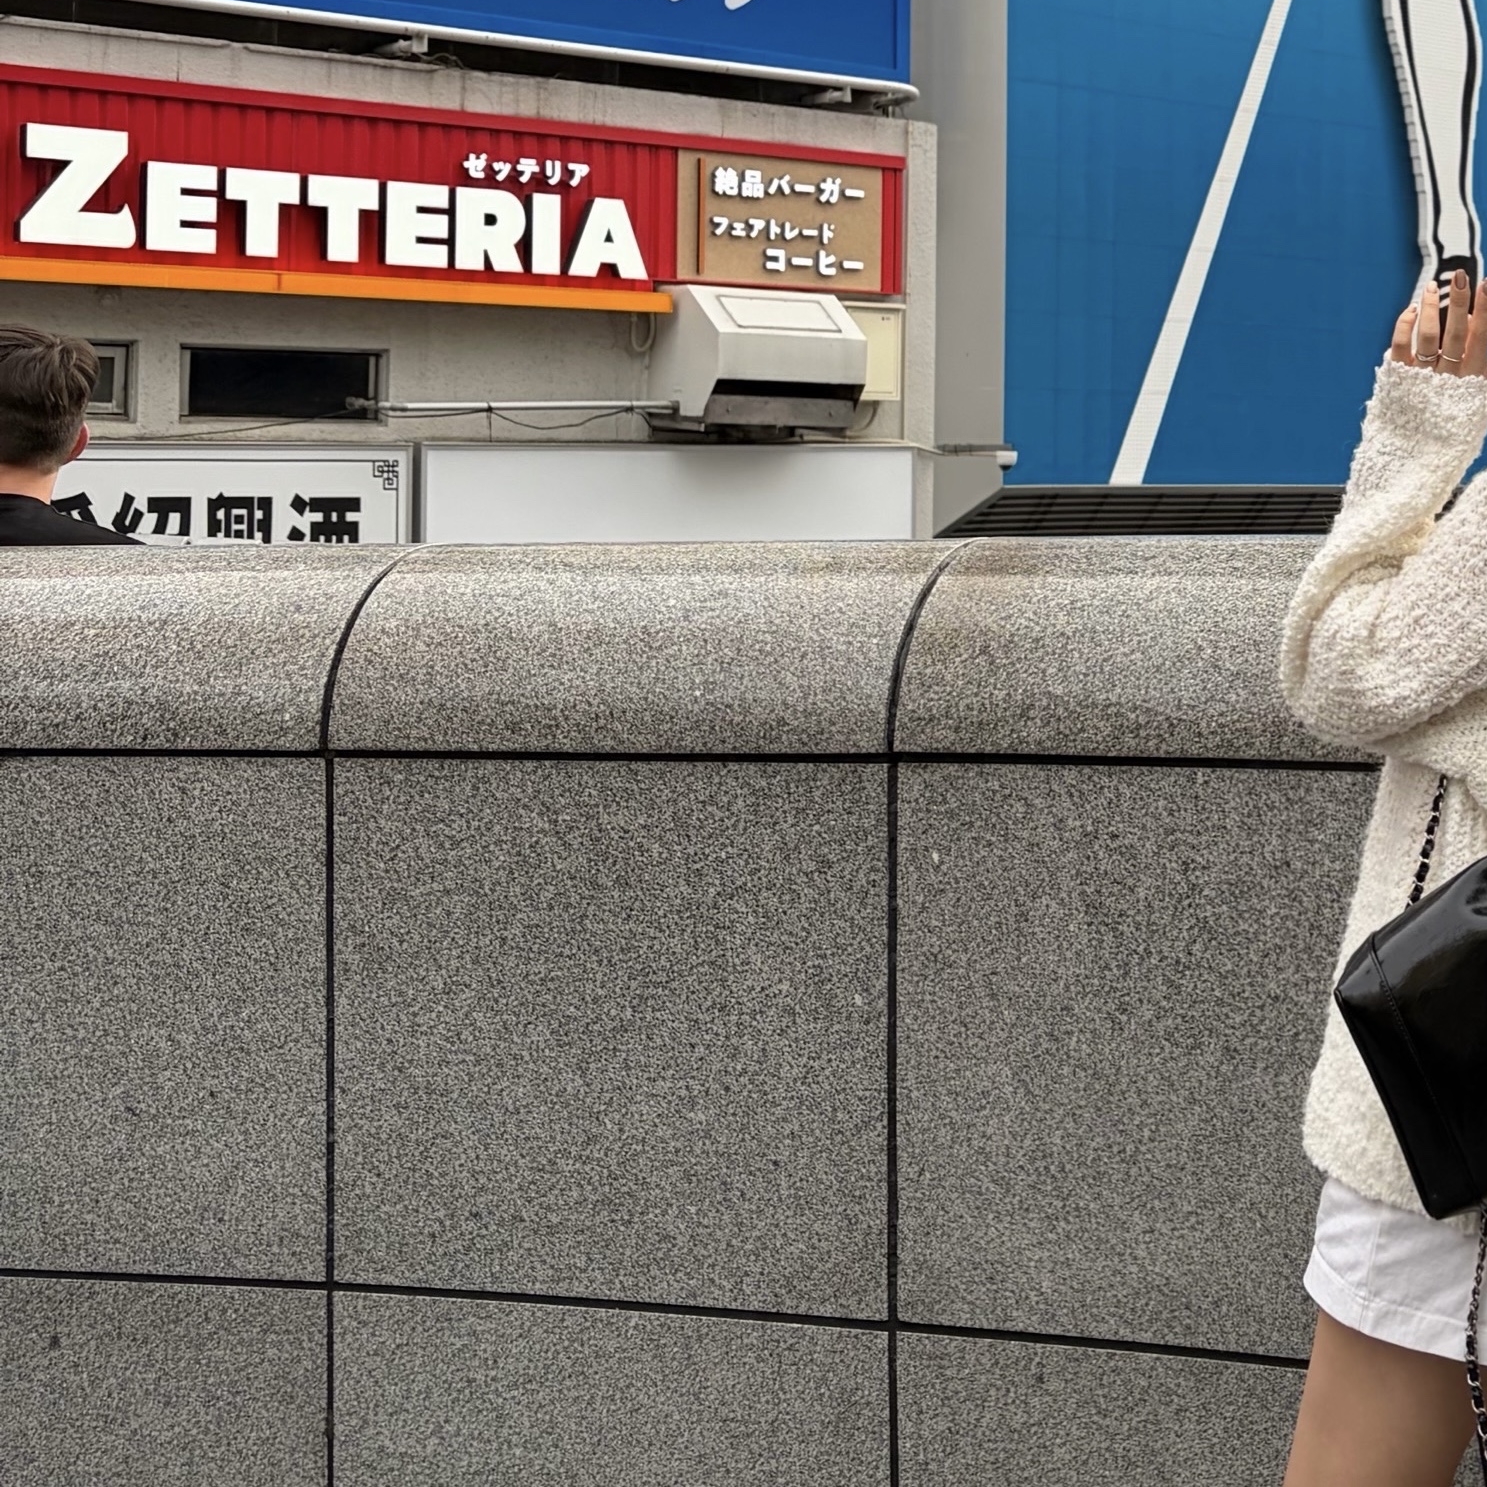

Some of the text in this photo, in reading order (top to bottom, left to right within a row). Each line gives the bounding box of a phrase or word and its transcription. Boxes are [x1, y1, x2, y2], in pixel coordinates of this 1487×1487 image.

[462, 152, 591, 187] ゼッテリア
[714, 166, 865, 204] 絶品バーガー
[19, 122, 648, 281] ZETTERIA
[712, 216, 835, 244] フェアトレード
[765, 248, 864, 276] コーヒー
